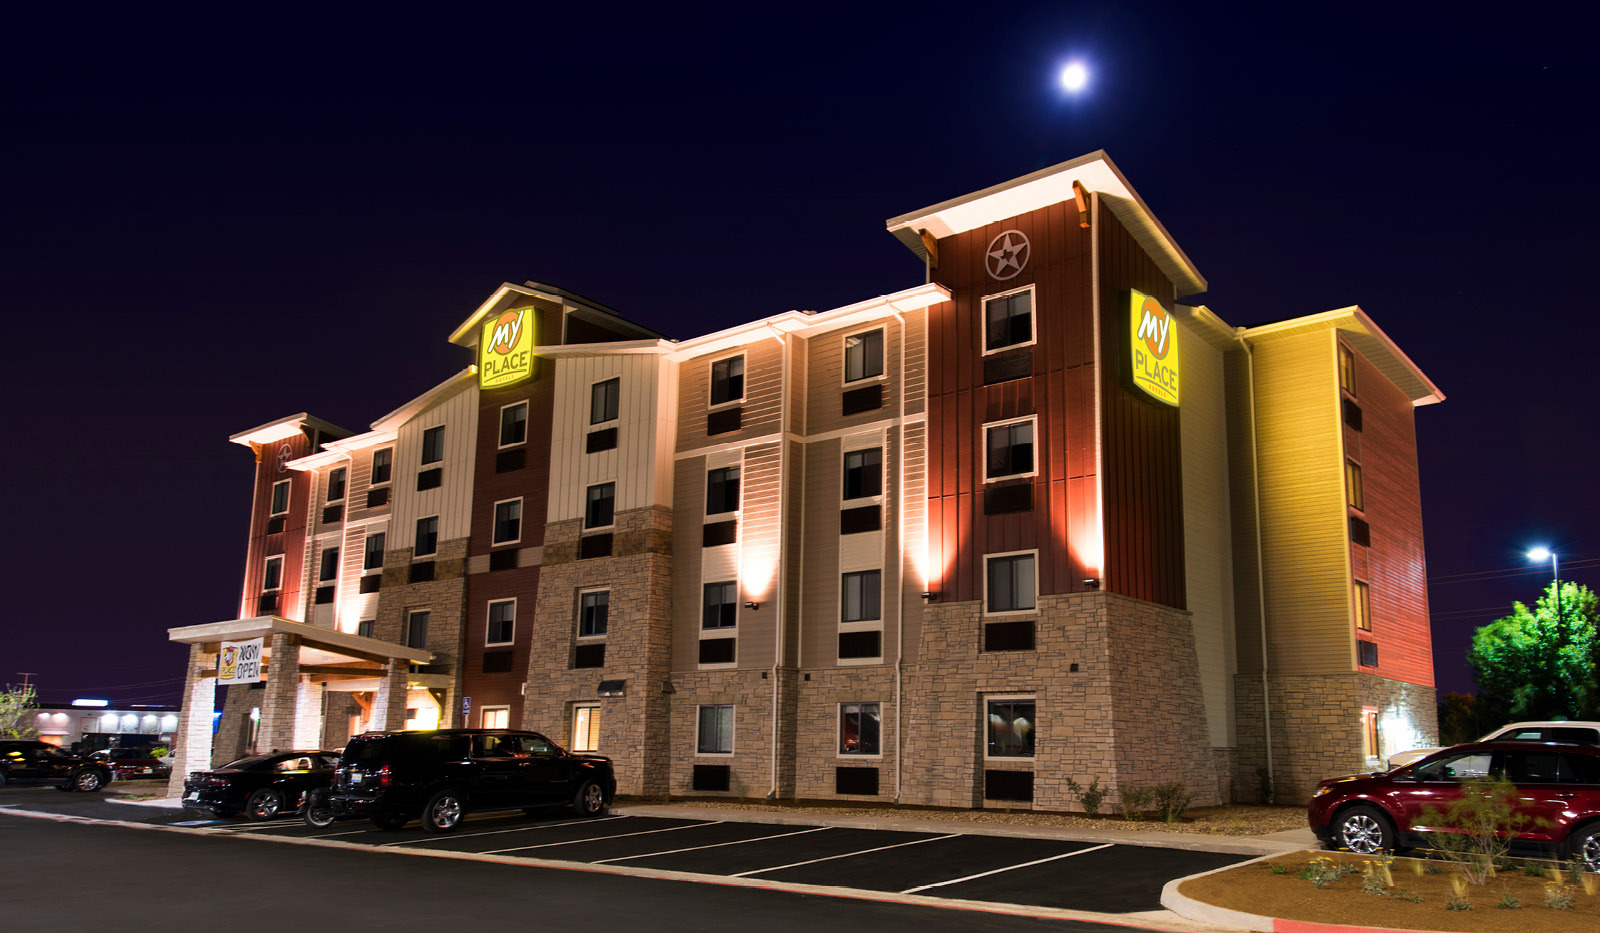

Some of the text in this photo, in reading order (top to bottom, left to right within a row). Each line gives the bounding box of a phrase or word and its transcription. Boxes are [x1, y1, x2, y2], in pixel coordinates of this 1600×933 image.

[483, 350, 528, 378] PLACE
[1135, 349, 1177, 392] PLACE
[239, 643, 261, 661] NOW
[237, 661, 259, 679] OPEN
